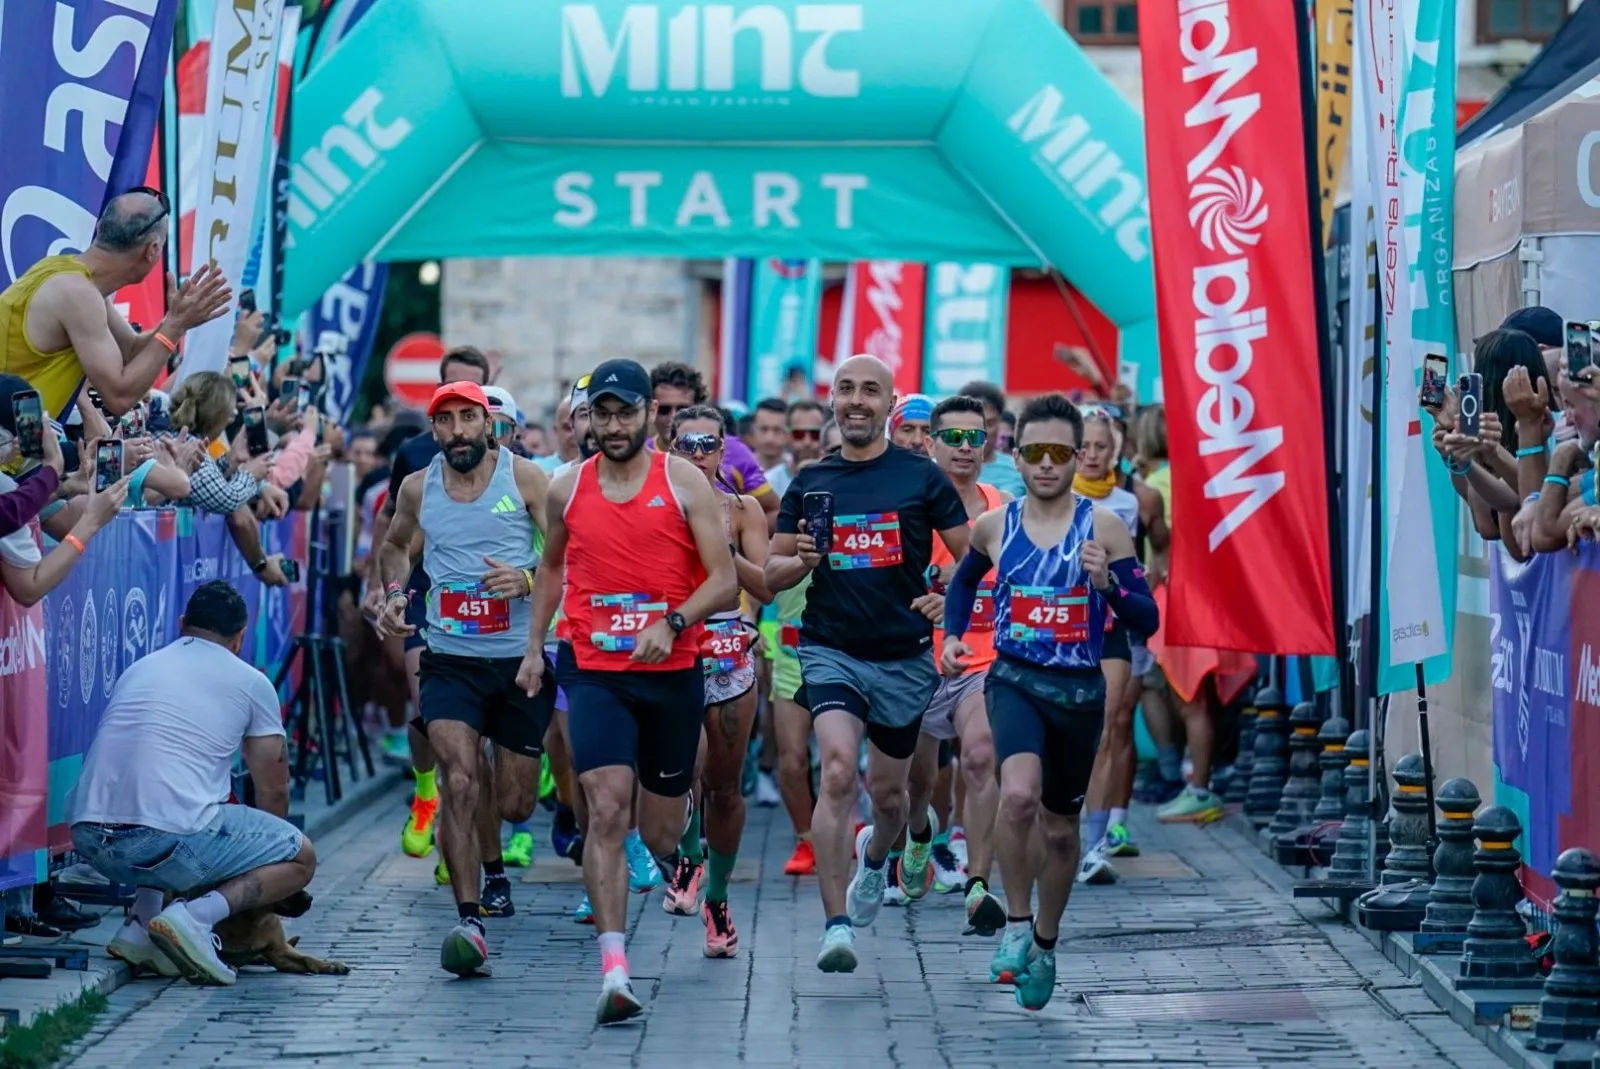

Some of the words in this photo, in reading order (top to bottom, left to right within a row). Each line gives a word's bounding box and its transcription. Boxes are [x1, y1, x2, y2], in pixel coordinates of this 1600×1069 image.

[553, 171, 868, 229] START
[844, 532, 884, 550] 494
[457, 600, 489, 616] 451
[1028, 606, 1069, 623] 475
[611, 613, 648, 631] 257
[711, 636, 741, 654] 236
